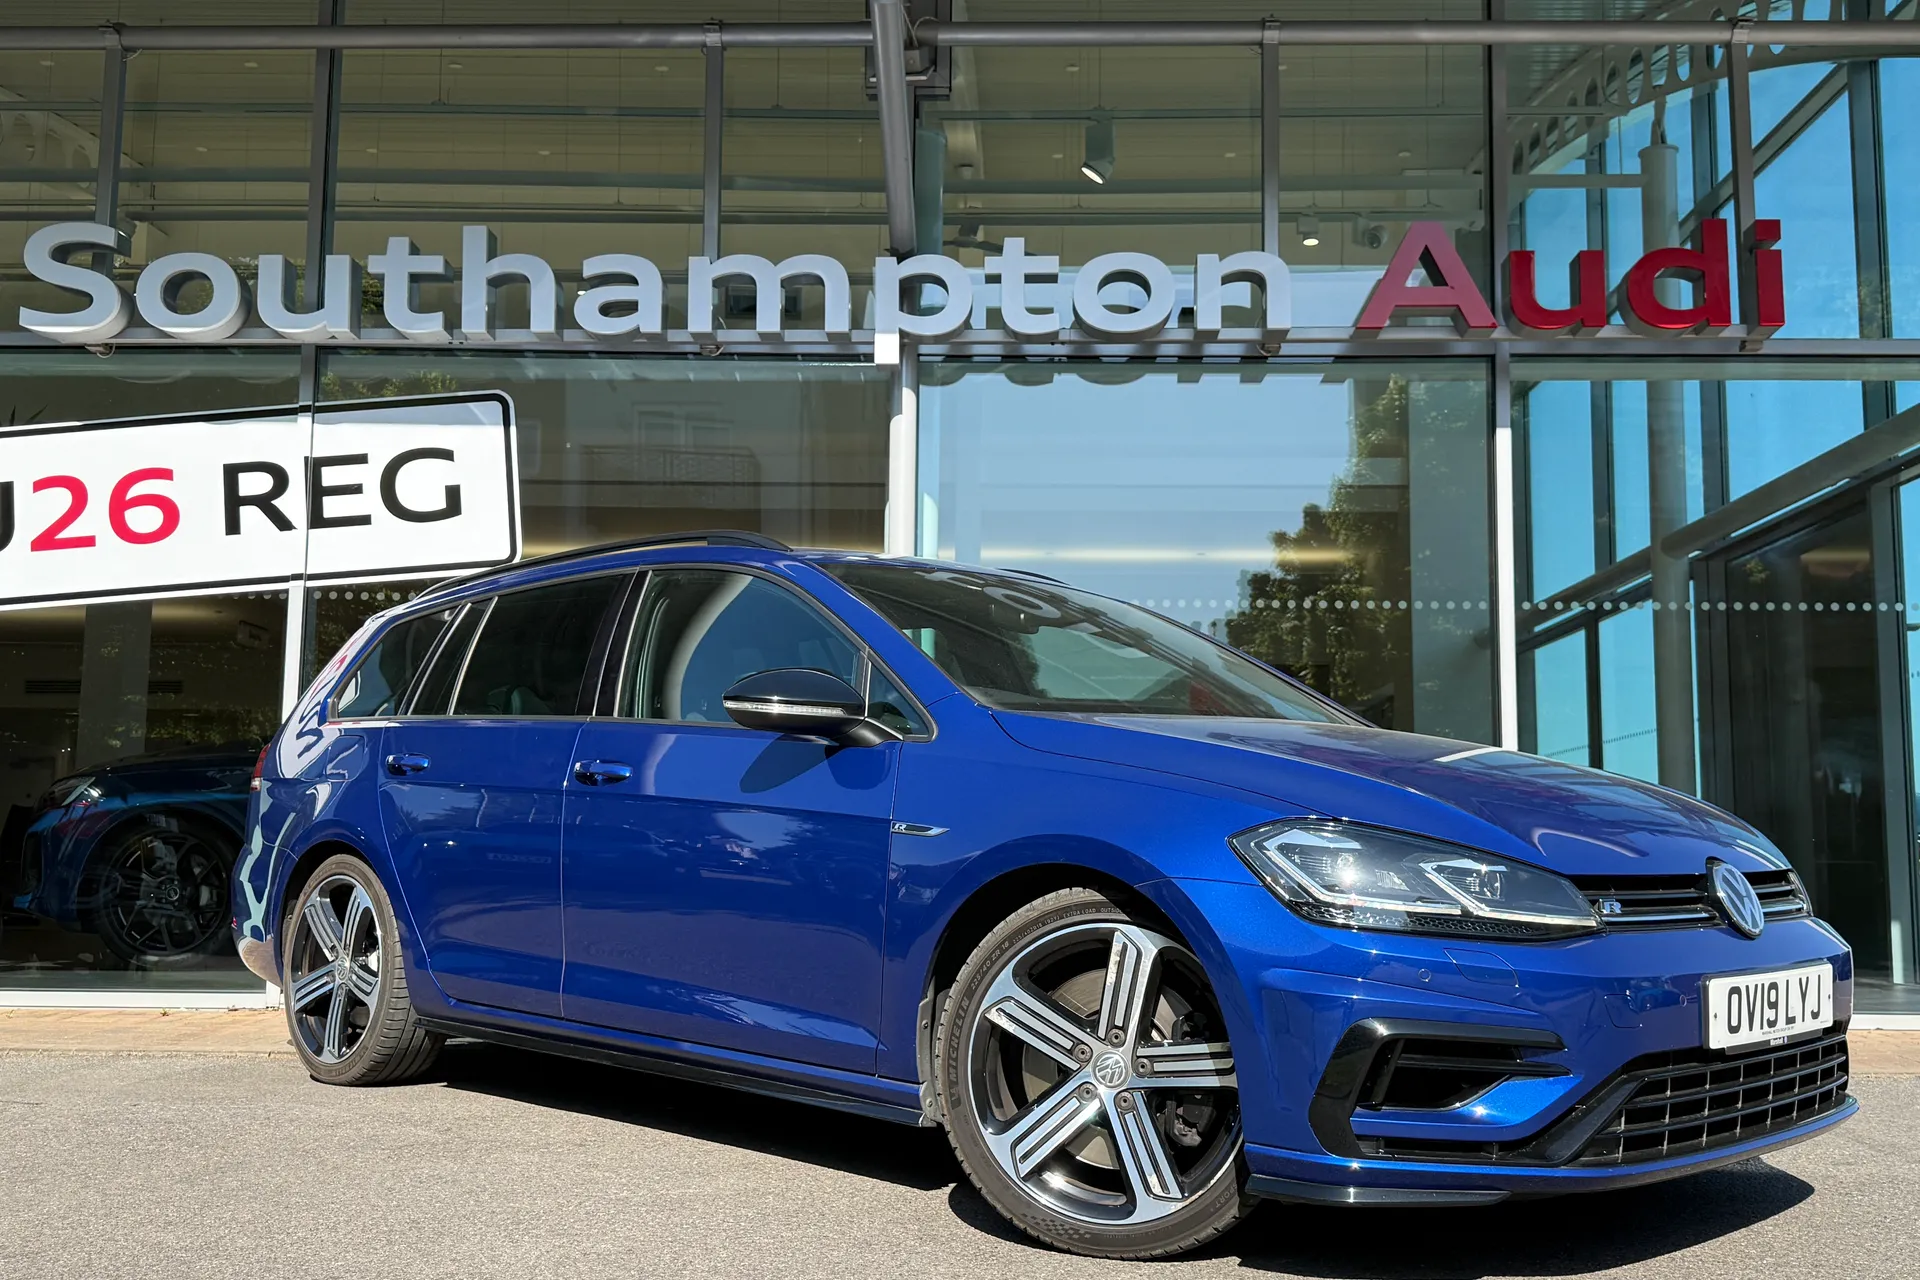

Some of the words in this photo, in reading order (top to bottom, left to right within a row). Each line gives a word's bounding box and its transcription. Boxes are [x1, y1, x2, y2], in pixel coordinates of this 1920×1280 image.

[19, 222, 1292, 366] Southampton
[1354, 218, 1786, 336] Audi
[222, 447, 463, 536] REG
[949, 997, 969, 1082] MICHELIN
[1785, 974, 1821, 1026] LYJ
